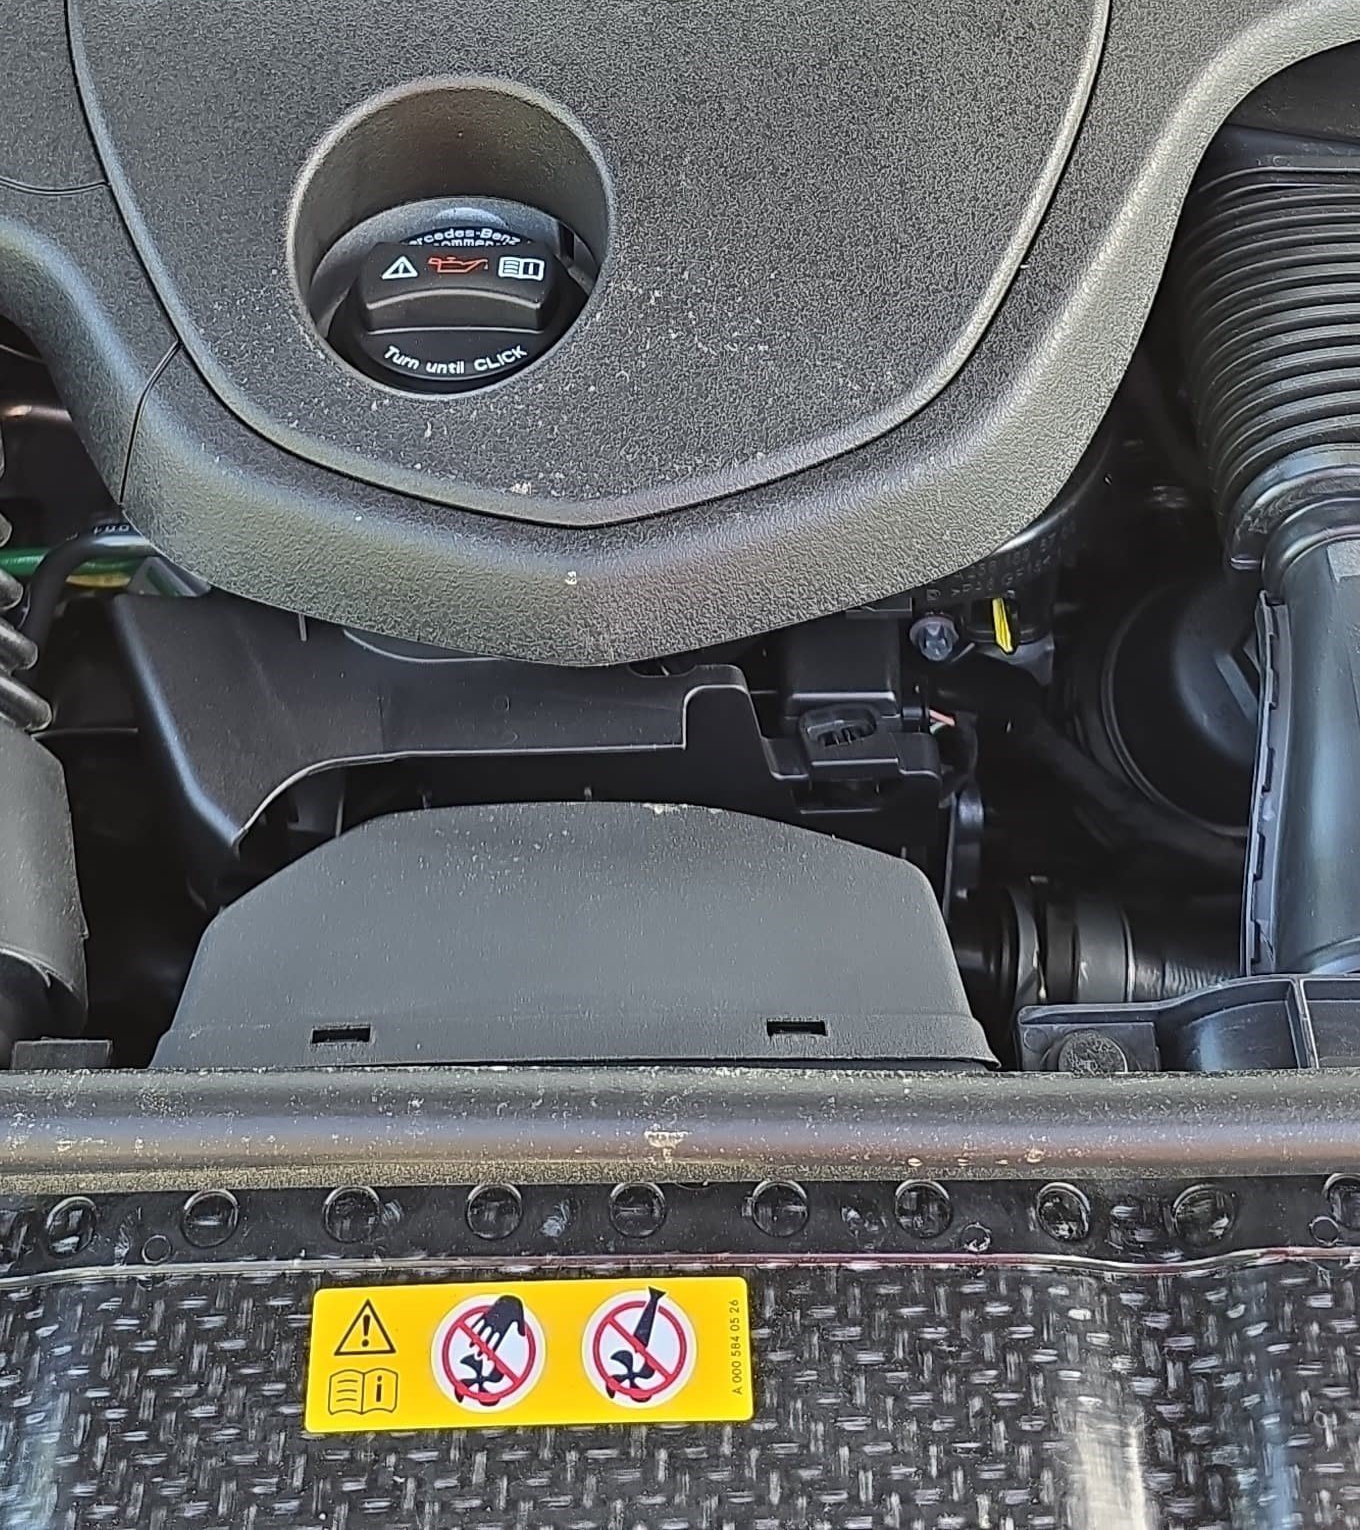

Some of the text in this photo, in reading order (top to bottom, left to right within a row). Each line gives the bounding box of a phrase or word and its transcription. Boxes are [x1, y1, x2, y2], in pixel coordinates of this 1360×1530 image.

[407, 228, 520, 246] ercedes-Benz
[384, 345, 528, 374] Turn until CLICK
[729, 1300, 742, 1395] A 000 584 05 26
